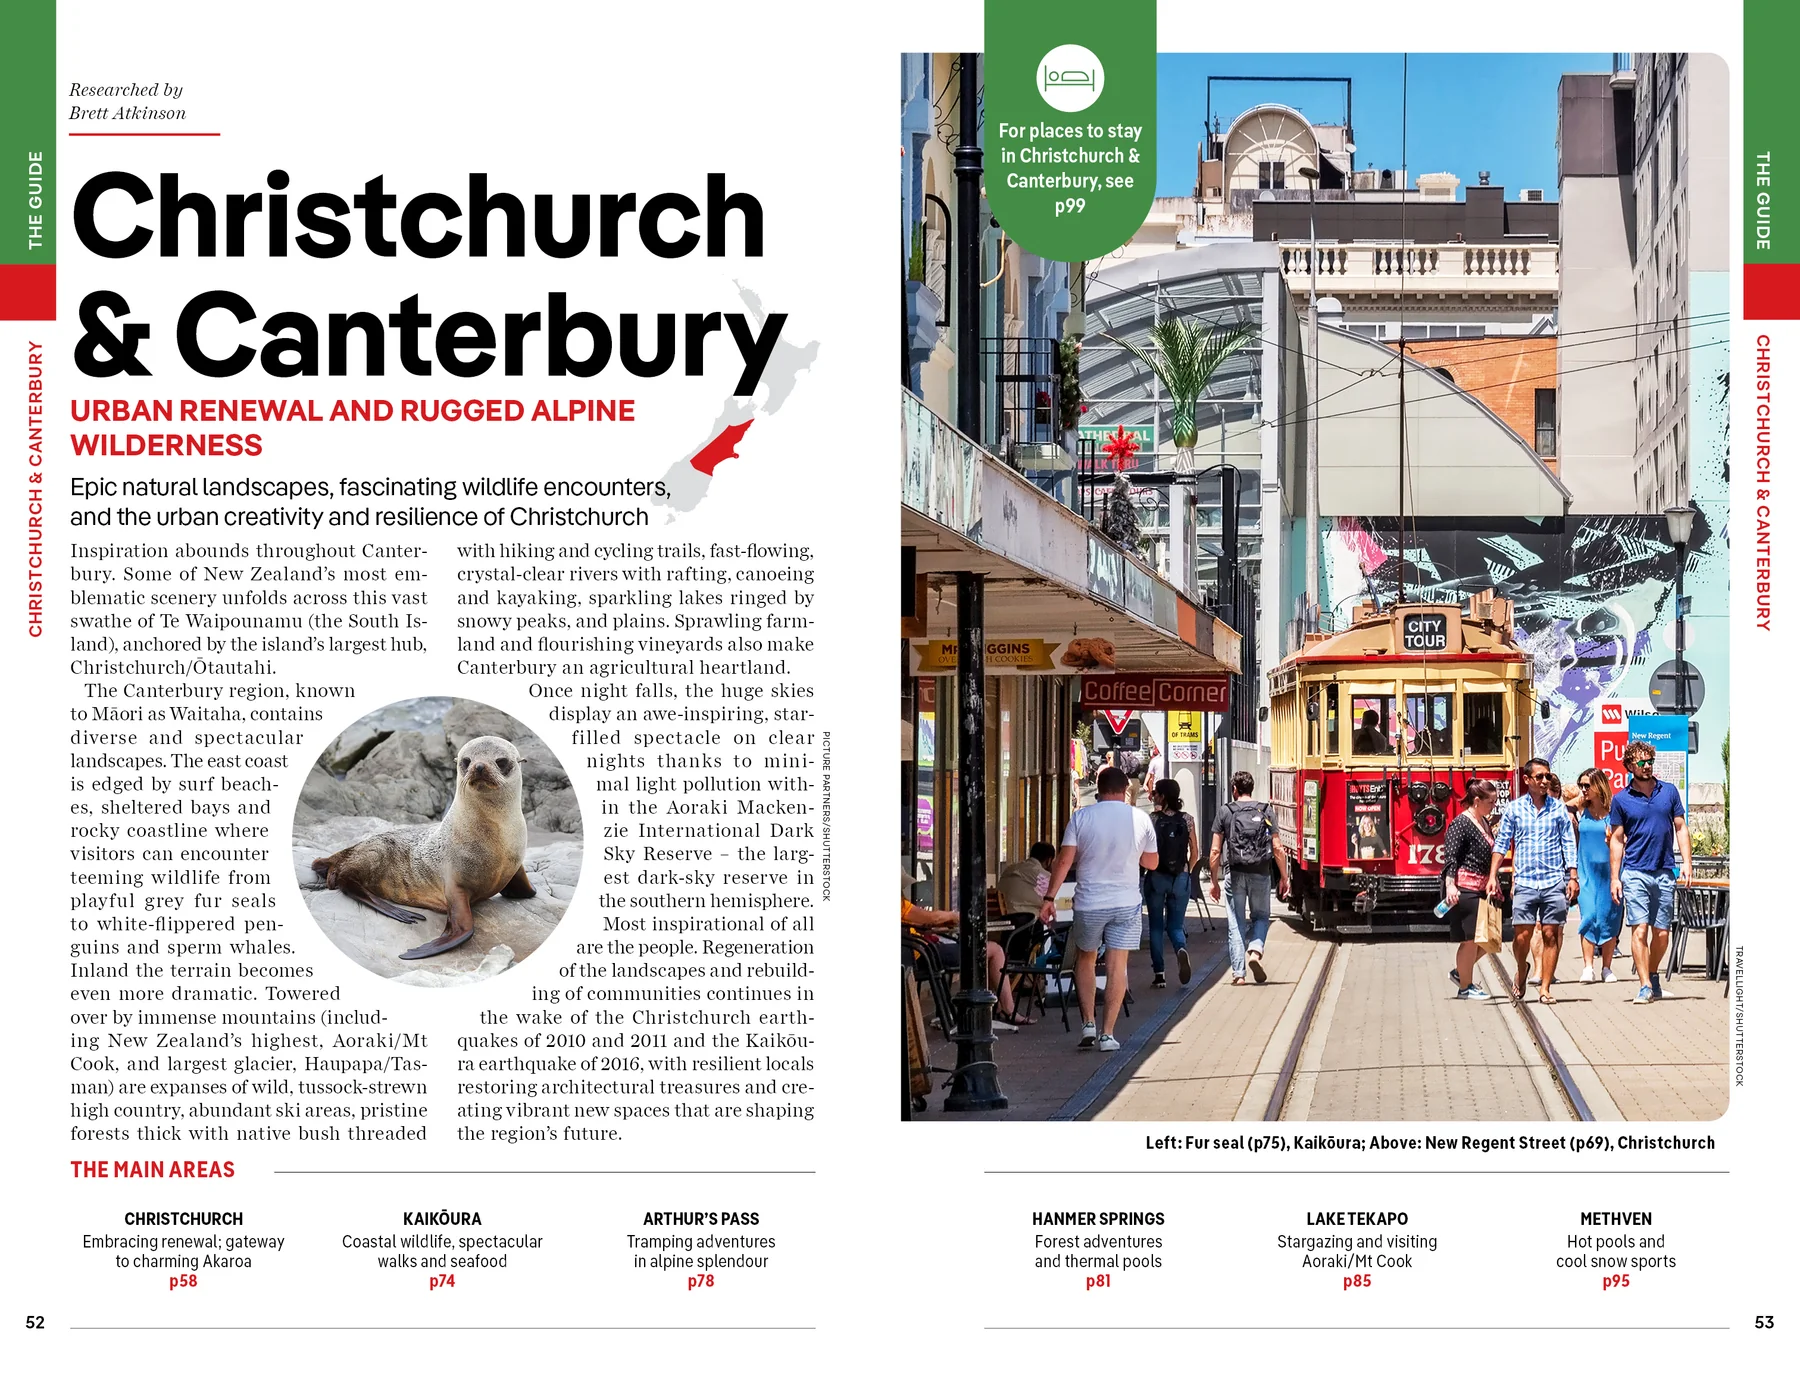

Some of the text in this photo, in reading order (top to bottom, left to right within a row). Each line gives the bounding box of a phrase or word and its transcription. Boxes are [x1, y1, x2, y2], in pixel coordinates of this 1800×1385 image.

[69, 83, 182, 99] Researched by
[69, 106, 185, 119] Brett Atkinson
[1000, 122, 1142, 142] For places to stay
[1002, 147, 1140, 163] in Christchurch &
[1007, 172, 1133, 192] Canterbury, see
[29, 152, 42, 250] THE GUIDE
[1056, 198, 1085, 217] p99
[1757, 152, 1770, 249] THE GUIDE
[74, 170, 763, 258] Christchurch
[74, 290, 788, 396] & Canterbury
[72, 399, 634, 422] URBAN RENEWAL AND RUGGED ALPINE
[70, 434, 262, 456] WILDERNESS
[1111, 459, 1139, 470] TRU
[29, 341, 42, 637] CHRISTCHURCH & CANTERBURY
[72, 477, 670, 500] Epic natural landscapes, fascinating wildlife encounters,
[1757, 335, 1770, 631] CHRISTCHURCH & CANTERBURY
[71, 507, 648, 529] and the urban creativity and resilience of Christchurch
[1408, 620, 1441, 632] CITY
[985, 643, 1030, 654] IGGINS
[1405, 634, 1446, 647] TOUR
[71, 657, 275, 677] Christchurch/Ōtautahi.
[938, 655, 956, 664] OVE
[995, 655, 1033, 663] COOKIES
[1085, 681, 1226, 702] Coffee Corner
[1625, 710, 1659, 719] Wilso
[1648, 732, 1671, 740] Regent
[1408, 844, 1445, 864] 178
[71, 940, 294, 957] guins and sperm whales.
[480, 1010, 814, 1024] the wake of the Christchurch earth-
[1147, 1135, 1714, 1152] Left: Fur seal (p75), Kaikōura; Above: New Regent Street (p69), Christchurch
[71, 1161, 234, 1177] THE MAIN AREAS
[125, 1212, 242, 1225] CHRISTCHURCH
[404, 1209, 482, 1225] KAIKŌURA
[643, 1212, 759, 1225] ARTHUR’S PASS
[1033, 1212, 1164, 1225] HANMER SPRINGS
[1308, 1212, 1408, 1225] LAKE TEKAPO
[1581, 1212, 1651, 1225] METHVEN
[84, 1234, 284, 1251] Embracing renewal; gateway
[343, 1234, 543, 1251] Coastal wildlife, spectacular
[627, 1234, 775, 1251] Tramping adventures
[1036, 1234, 1162, 1248] Forest adventures
[1278, 1234, 1436, 1251] Stargazing and visiting
[1568, 1234, 1664, 1251] Hot pools and
[116, 1254, 251, 1271] to charming Akaroa
[378, 1254, 506, 1267] walks and seafood
[635, 1254, 768, 1271] in alpine splendour
[1035, 1254, 1162, 1271] and thermal pools
[1303, 1253, 1412, 1269] Aoraki/Mt Cook
[1557, 1254, 1676, 1271] cool snow sports
[170, 1274, 197, 1291] p58
[430, 1274, 455, 1290] p74
[689, 1274, 714, 1290] p78
[1087, 1274, 1110, 1291] p81
[1344, 1274, 1371, 1290] p85
[1603, 1274, 1629, 1290] p95
[26, 1316, 44, 1329] 52
[1755, 1316, 1774, 1329] 53
